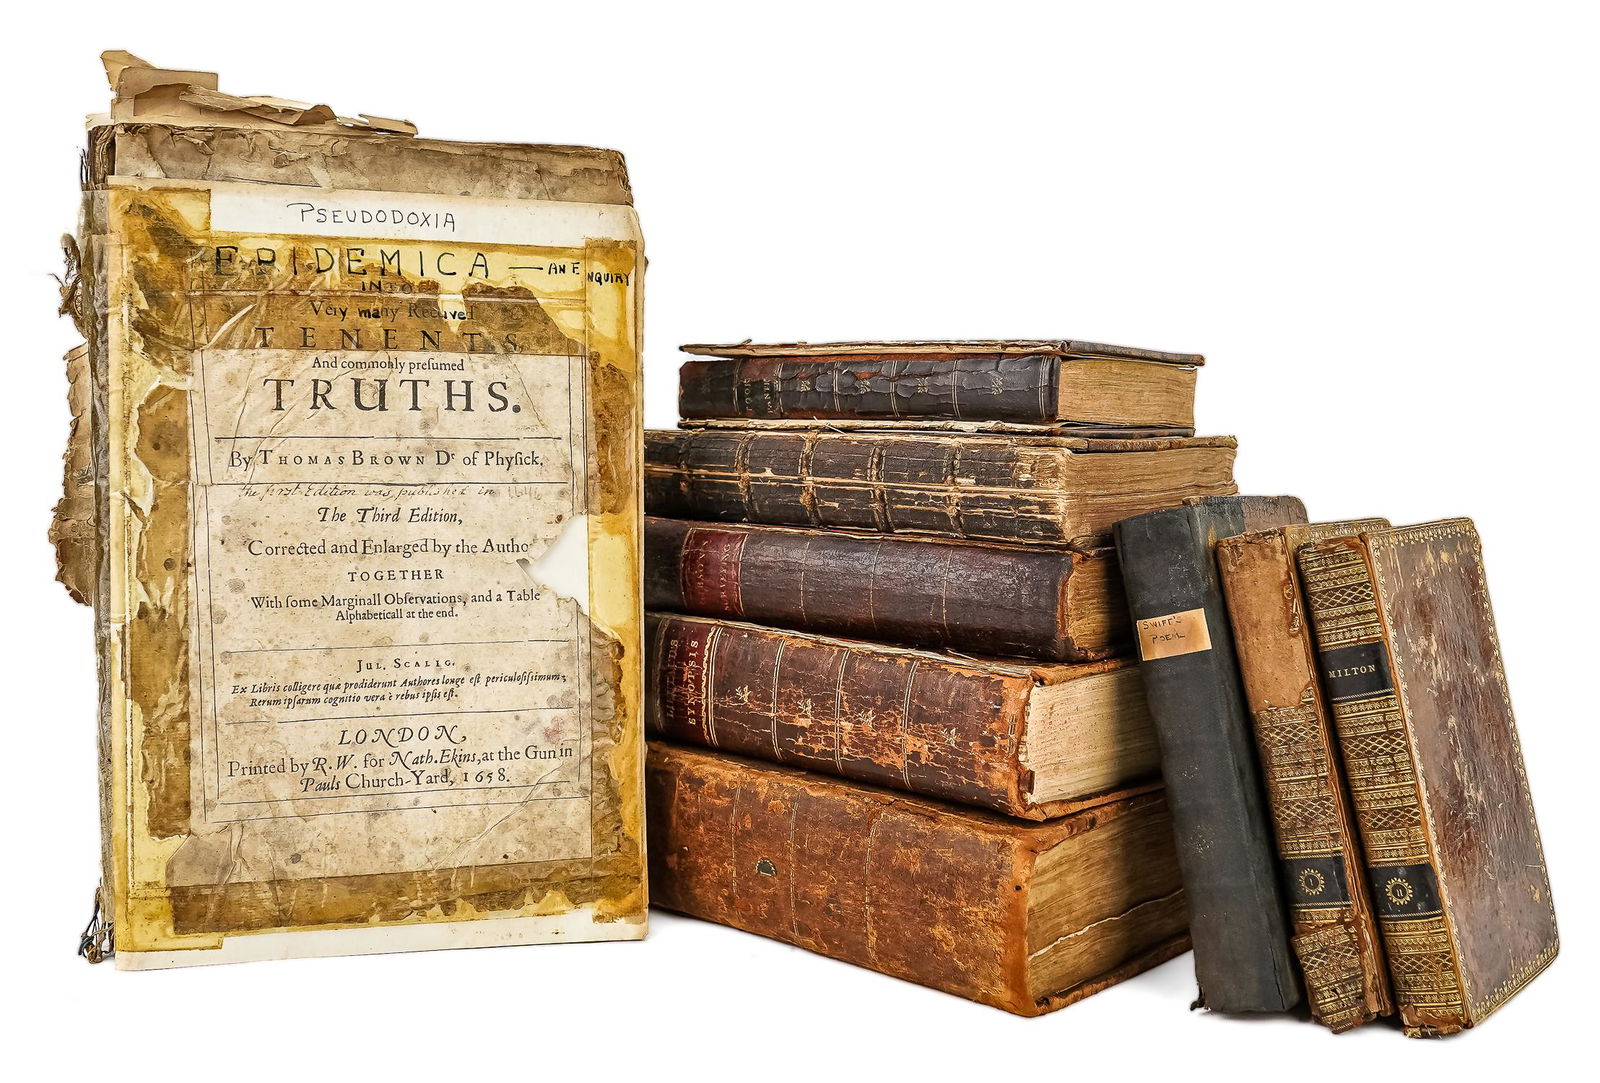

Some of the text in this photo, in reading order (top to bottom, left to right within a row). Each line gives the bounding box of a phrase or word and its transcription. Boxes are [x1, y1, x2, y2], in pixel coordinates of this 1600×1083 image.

[287, 202, 455, 232] PSEUDODOXIA
[213, 245, 489, 279] EPIDEMICA
[547, 263, 566, 275] AN
[310, 300, 348, 321] Very
[358, 307, 399, 322] many
[312, 356, 338, 369] And
[341, 356, 405, 373] commonly
[263, 377, 522, 413] TRUTHS.
[230, 451, 253, 471] By
[258, 449, 345, 465] THOMAS
[352, 450, 425, 465] BROWN
[462, 451, 480, 466] of
[304, 484, 356, 497] Edition
[394, 484, 470, 501] published
[317, 506, 463, 525] The Third Edition,
[247, 538, 532, 558] Corrected and Enlarged by the Autho
[347, 569, 444, 582] TOGETHER
[251, 596, 282, 609] With
[320, 593, 382, 610] Marginall
[471, 590, 492, 602] and
[496, 594, 503, 602] a
[507, 589, 541, 601] Table
[335, 607, 459, 624] Alphabeticall at the end.
[1328, 664, 1376, 679] MILTON
[231, 686, 247, 694] Ex
[251, 683, 281, 694] Libris
[282, 681, 321, 695] colligere
[342, 678, 397, 693] prodiderunt
[400, 675, 440, 688] Authores
[687, 640, 699, 725] SYNOPSIS
[249, 697, 282, 707] Rerum
[323, 695, 361, 707] cognitio
[395, 690, 420, 701] rebus
[338, 725, 467, 748] LONDON,
[227, 758, 286, 777] Printed
[290, 757, 310, 777] by
[363, 753, 385, 768] for
[498, 746, 520, 761] the
[525, 744, 556, 760] Gun
[559, 743, 573, 758] in
[300, 775, 341, 793] Pauls
